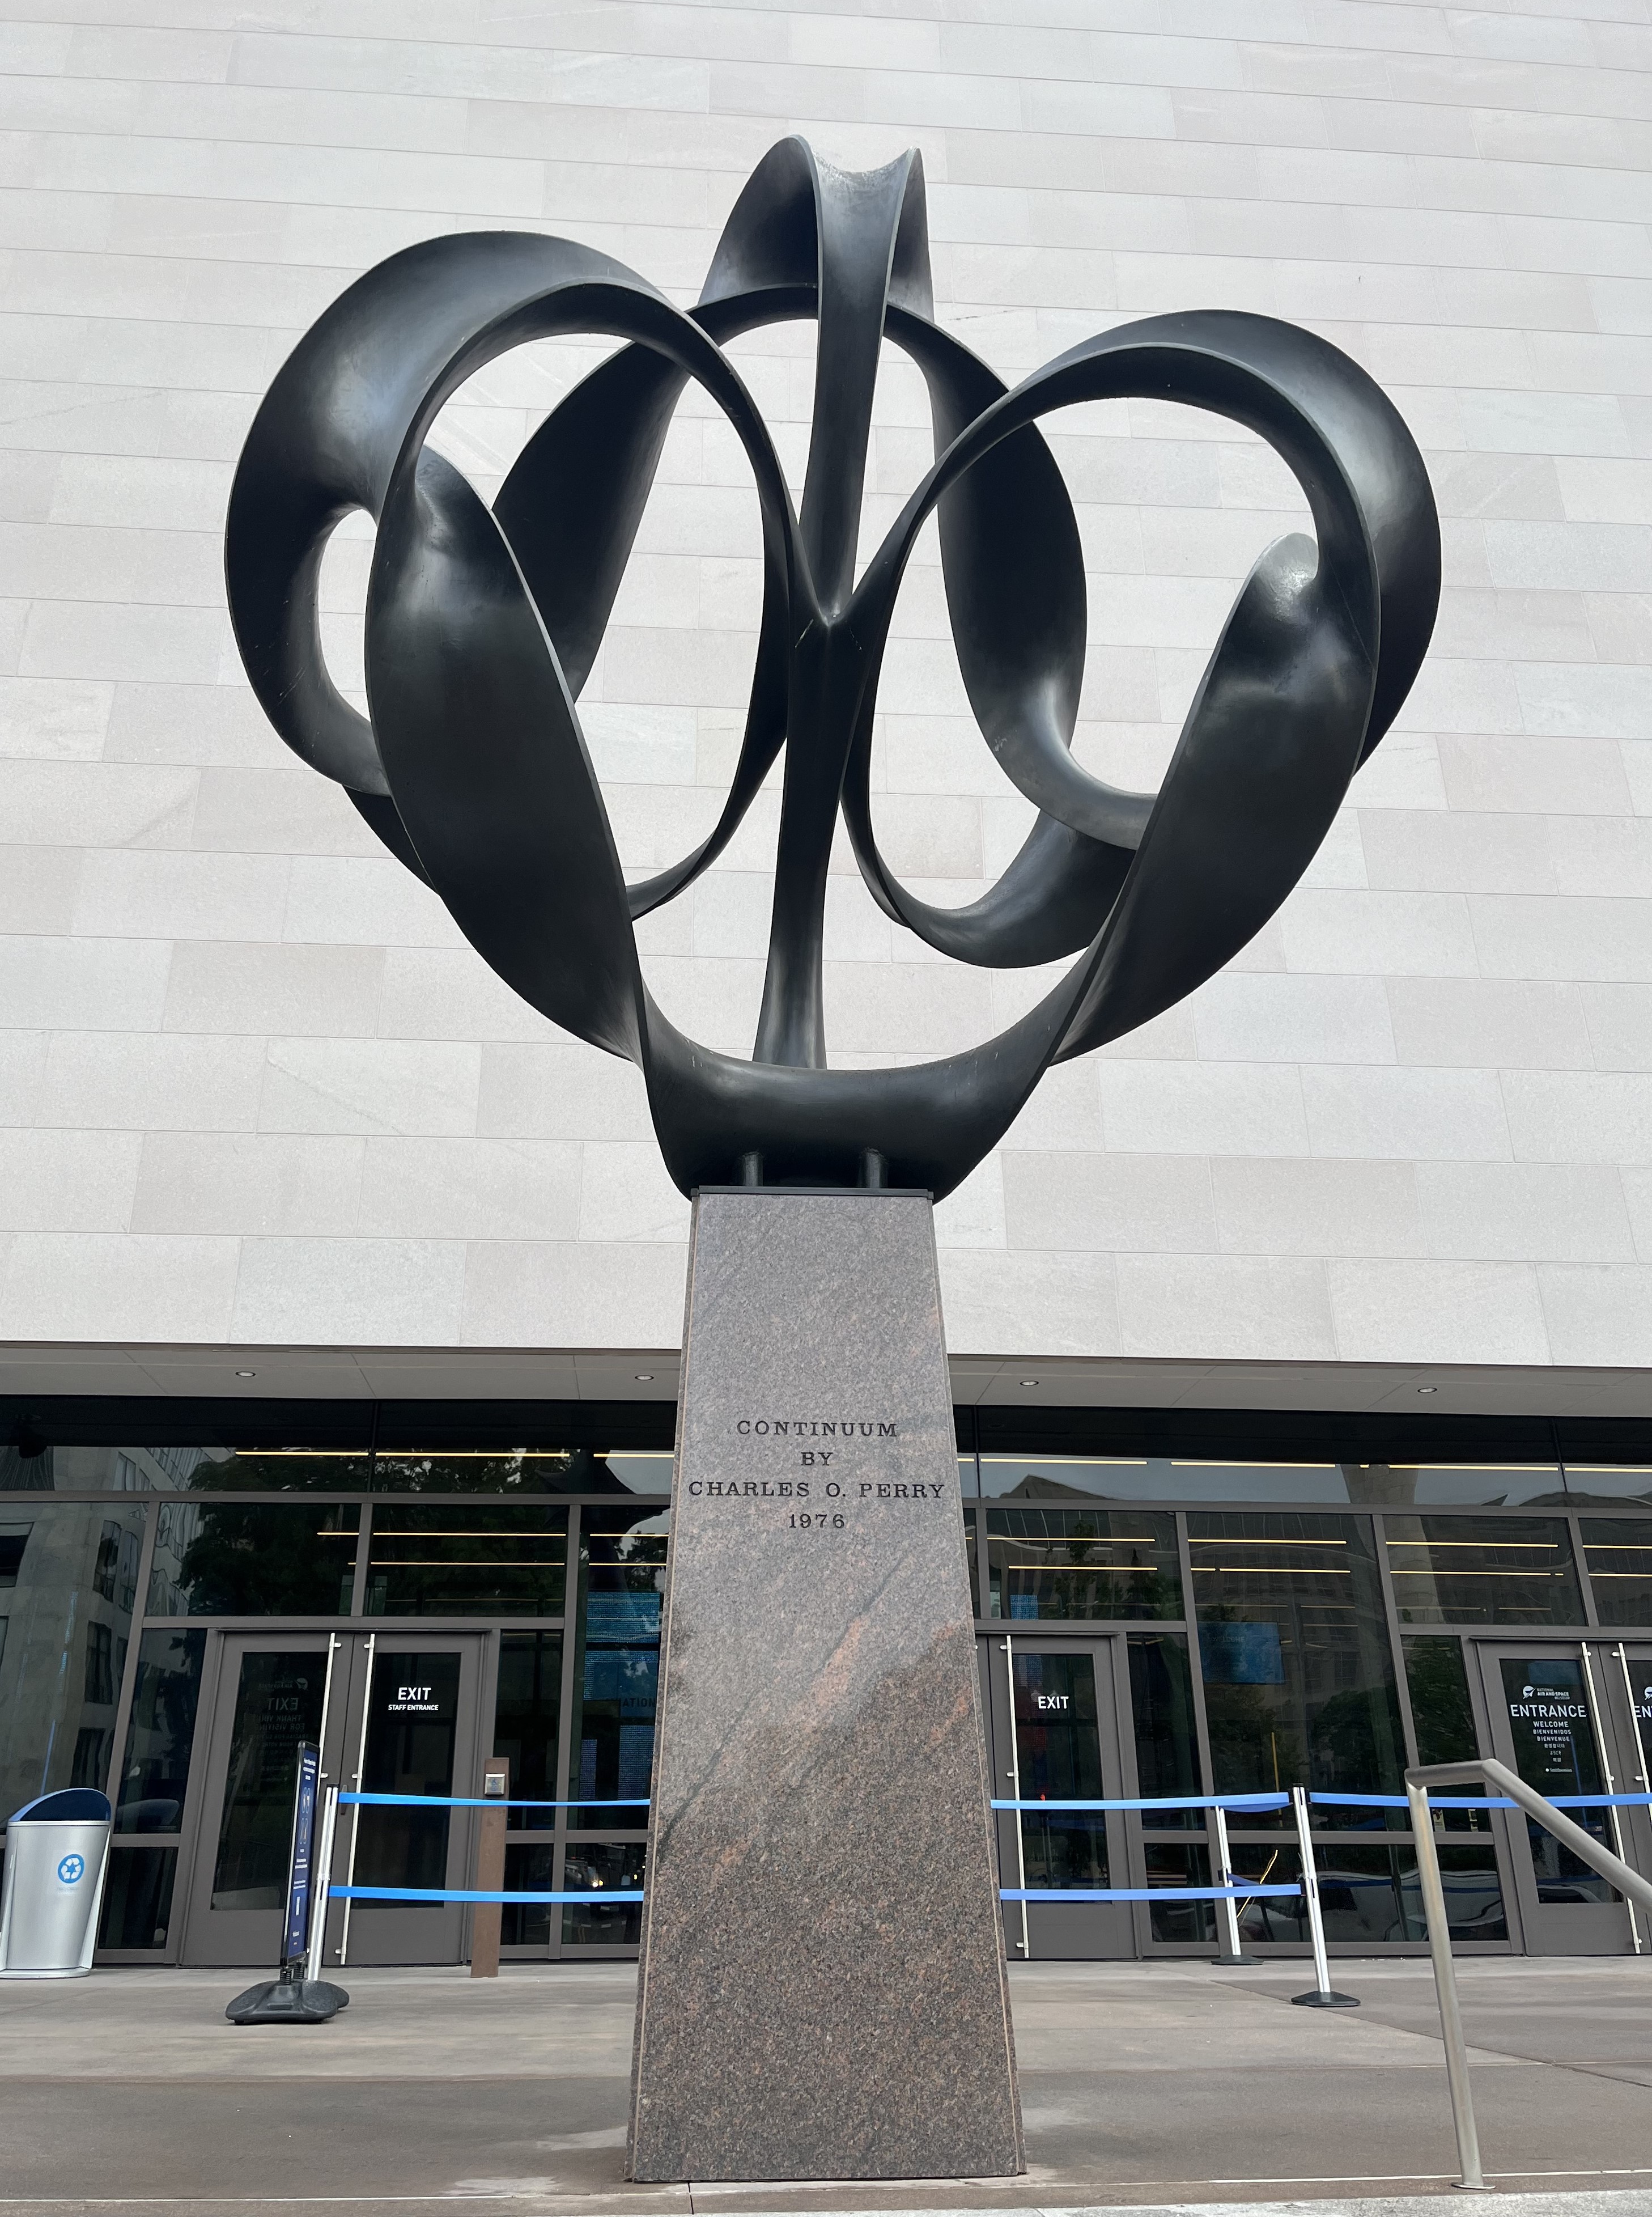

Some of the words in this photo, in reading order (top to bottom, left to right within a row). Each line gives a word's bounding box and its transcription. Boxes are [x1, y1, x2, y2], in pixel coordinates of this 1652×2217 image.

[737, 1421, 898, 1438] CONTINUUM
[801, 1452, 834, 1466] BY
[689, 1481, 809, 1497] CHARLES
[826, 1482, 846, 1498] O.
[859, 1483, 945, 1498] PERRY
[789, 1514, 845, 1529] 1976
[398, 1687, 431, 1701] EXIT
[1038, 1696, 1069, 1709] EXIT
[1510, 1705, 1587, 1718] ENTRANCE
[1634, 1705, 1652, 1718] EN
